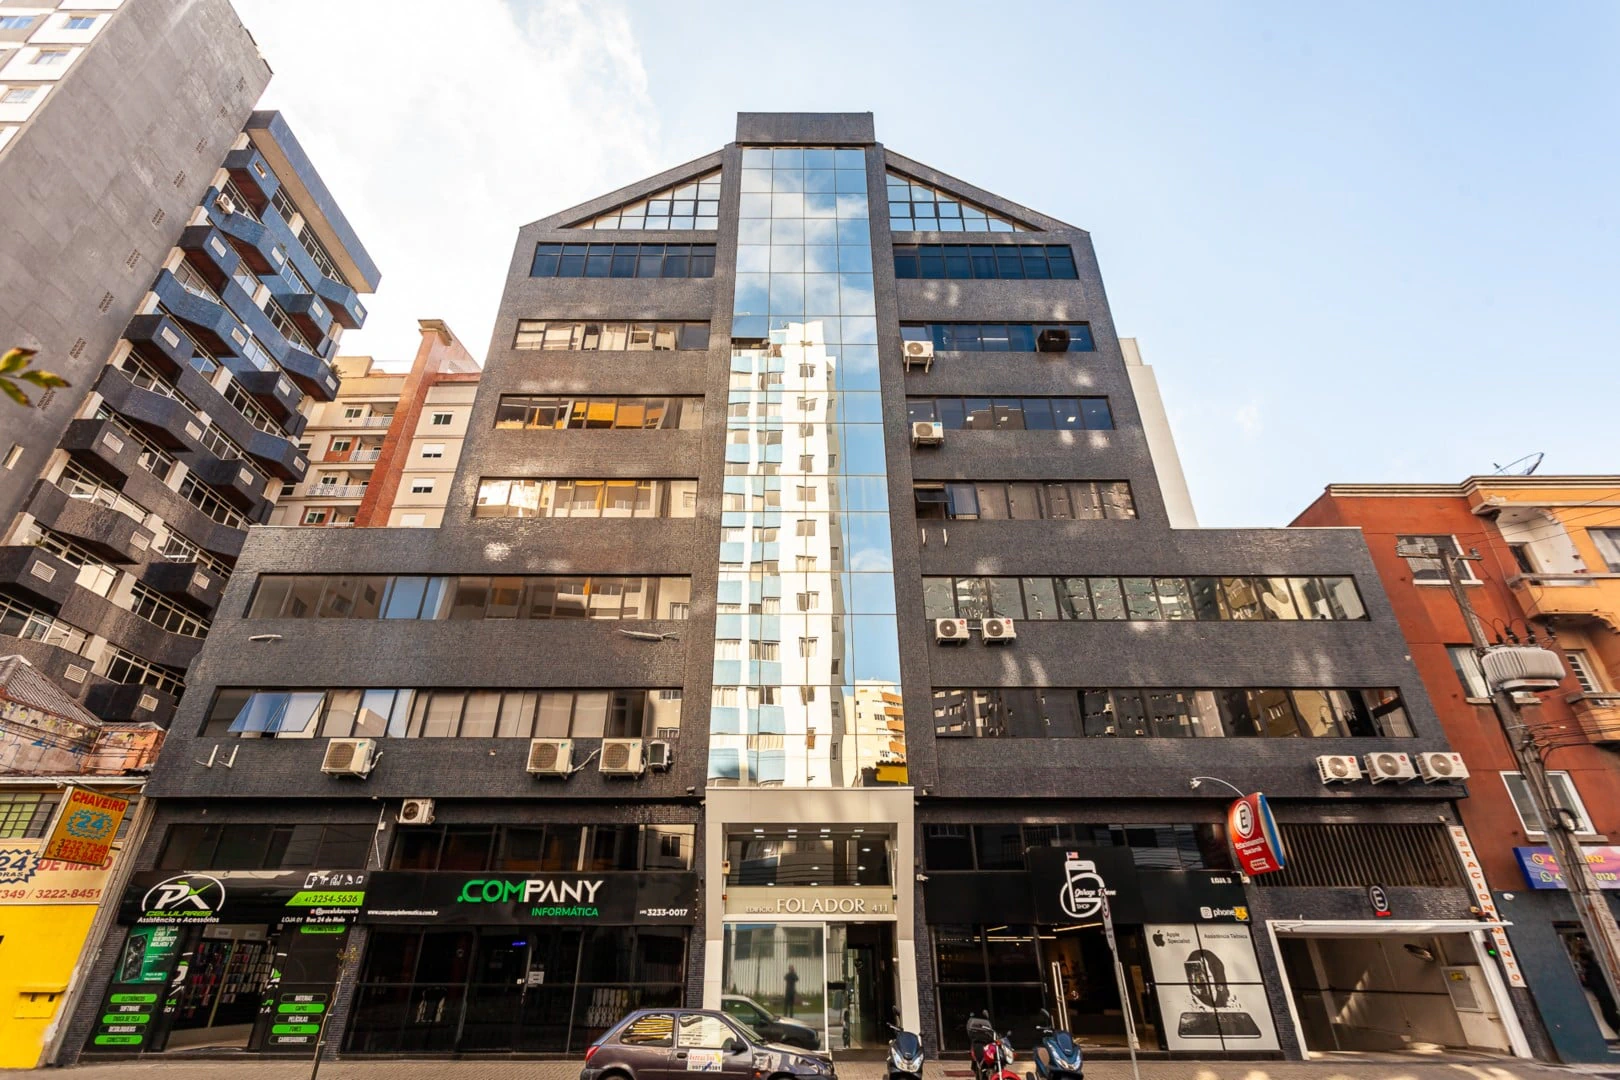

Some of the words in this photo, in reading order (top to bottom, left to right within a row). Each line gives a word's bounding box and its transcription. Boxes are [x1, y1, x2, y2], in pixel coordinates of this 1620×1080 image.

[72, 791, 126, 812] CHAVEIRO
[76, 814, 105, 830] 24
[1240, 809, 1249, 829] E
[0, 856, 28, 871] 24
[37, 859, 61, 871] DE
[0, 889, 26, 899] 349
[36, 889, 101, 899] 3222-8451
[312, 895, 358, 903] 3254-5636
[1372, 890, 1385, 907] E
[531, 906, 600, 917] INFORMÁTICA
[647, 908, 689, 917] 3233-0017
[776, 898, 867, 914] FOLADOR
[871, 904, 889, 913] 411
[136, 916, 176, 924] Assistência
[182, 916, 220, 924] Acessórios
